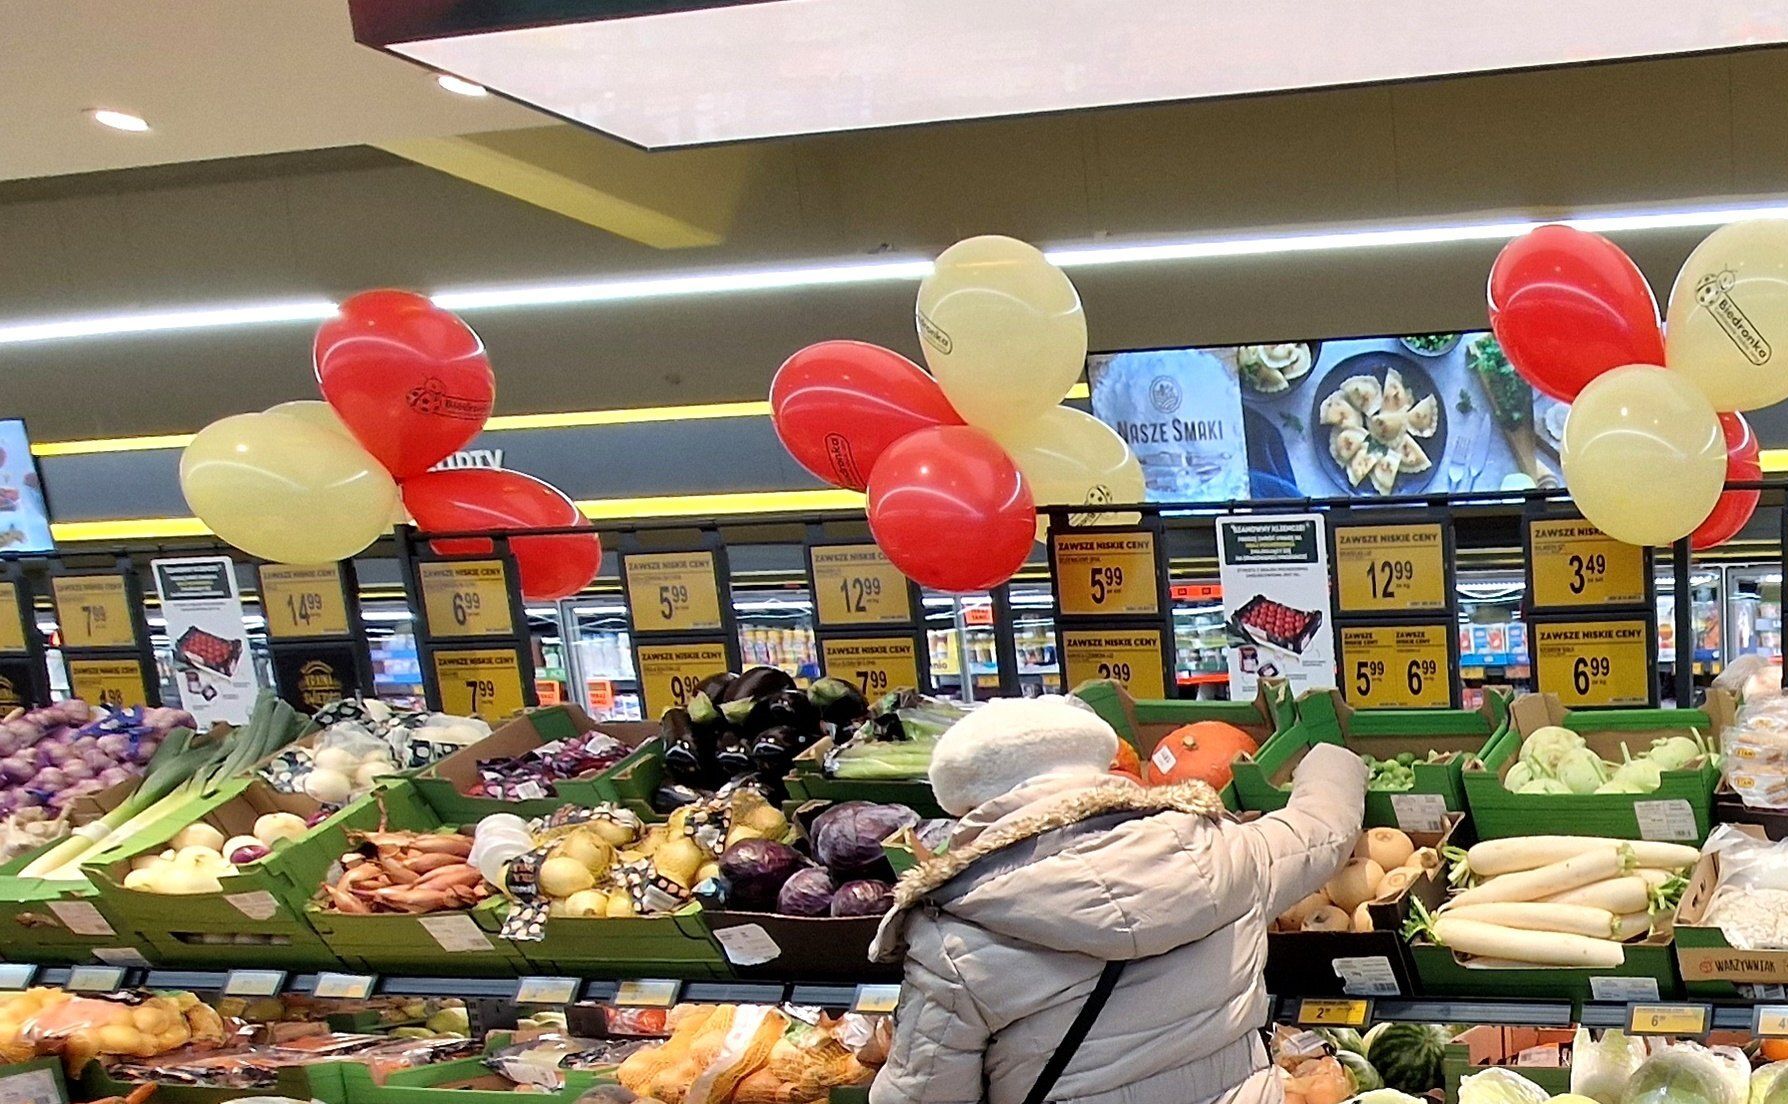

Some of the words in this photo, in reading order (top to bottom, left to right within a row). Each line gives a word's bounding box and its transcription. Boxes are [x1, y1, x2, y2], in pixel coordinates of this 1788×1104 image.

[1719, 299, 1766, 358] Biedronka
[1117, 420, 1168, 445] NASZE
[1173, 417, 1224, 442] SMAKI
[1535, 528, 1575, 538] ZAWSZE
[1578, 527, 1607, 536] NISK
[1340, 535, 1378, 544] ZAWSZE
[1380, 534, 1410, 543] NISKIE
[1412, 533, 1438, 542] CENY
[1058, 542, 1094, 551] ZAWSZE
[1097, 541, 1124, 550] NISKIE
[1126, 541, 1150, 550] CENY
[1540, 632, 1579, 640] ZAWSZE
[1582, 631, 1613, 640] NISKIE
[1615, 629, 1642, 638] CENY
[642, 652, 673, 661] ZAWSZE
[1714, 959, 1776, 973] WARZYWNIAK
